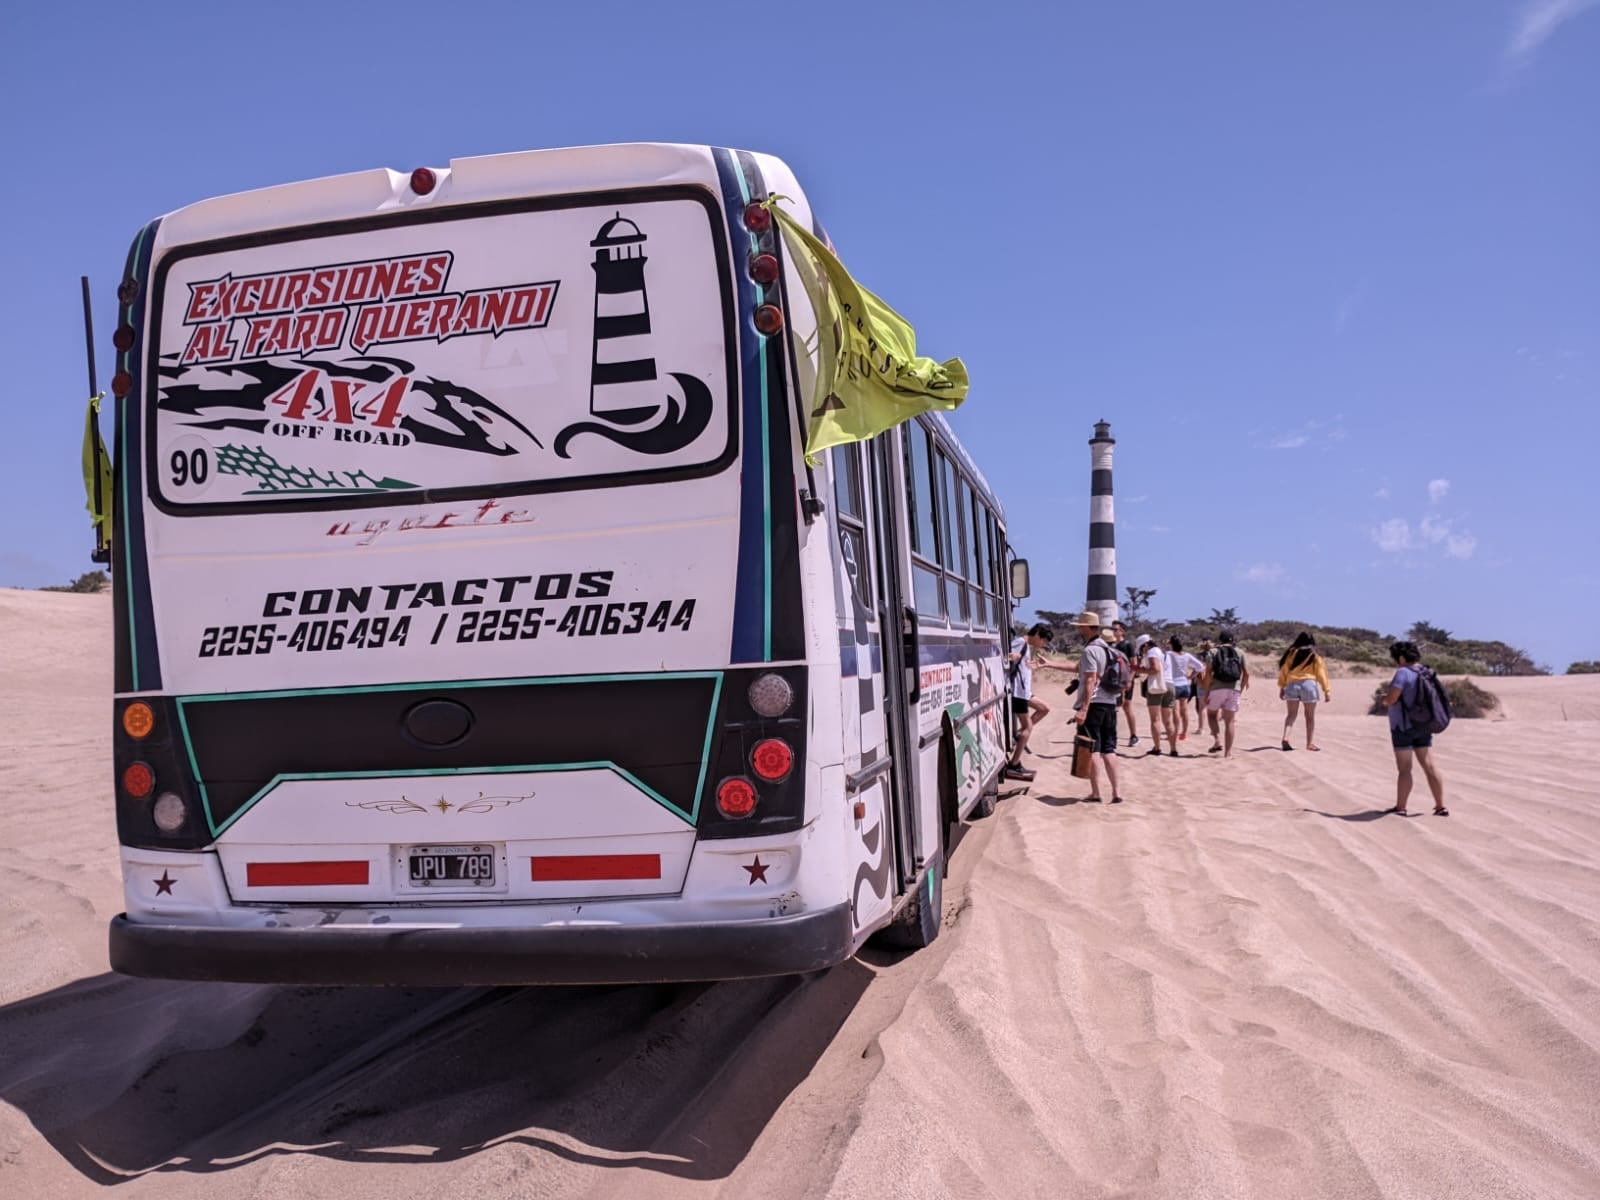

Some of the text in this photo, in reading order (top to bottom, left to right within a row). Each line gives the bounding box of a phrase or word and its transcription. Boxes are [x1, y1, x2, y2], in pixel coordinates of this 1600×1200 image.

[186, 254, 449, 320] EXCURSIONES
[184, 287, 552, 361] AL FARO QUERANDI
[272, 423, 411, 447] OFF ROAD
[170, 448, 208, 487] 90
[263, 571, 614, 617] CONTACTOS
[198, 615, 412, 658] 2255-406494
[456, 598, 697, 643] 2255-406344
[412, 856, 491, 879] JPU 789
